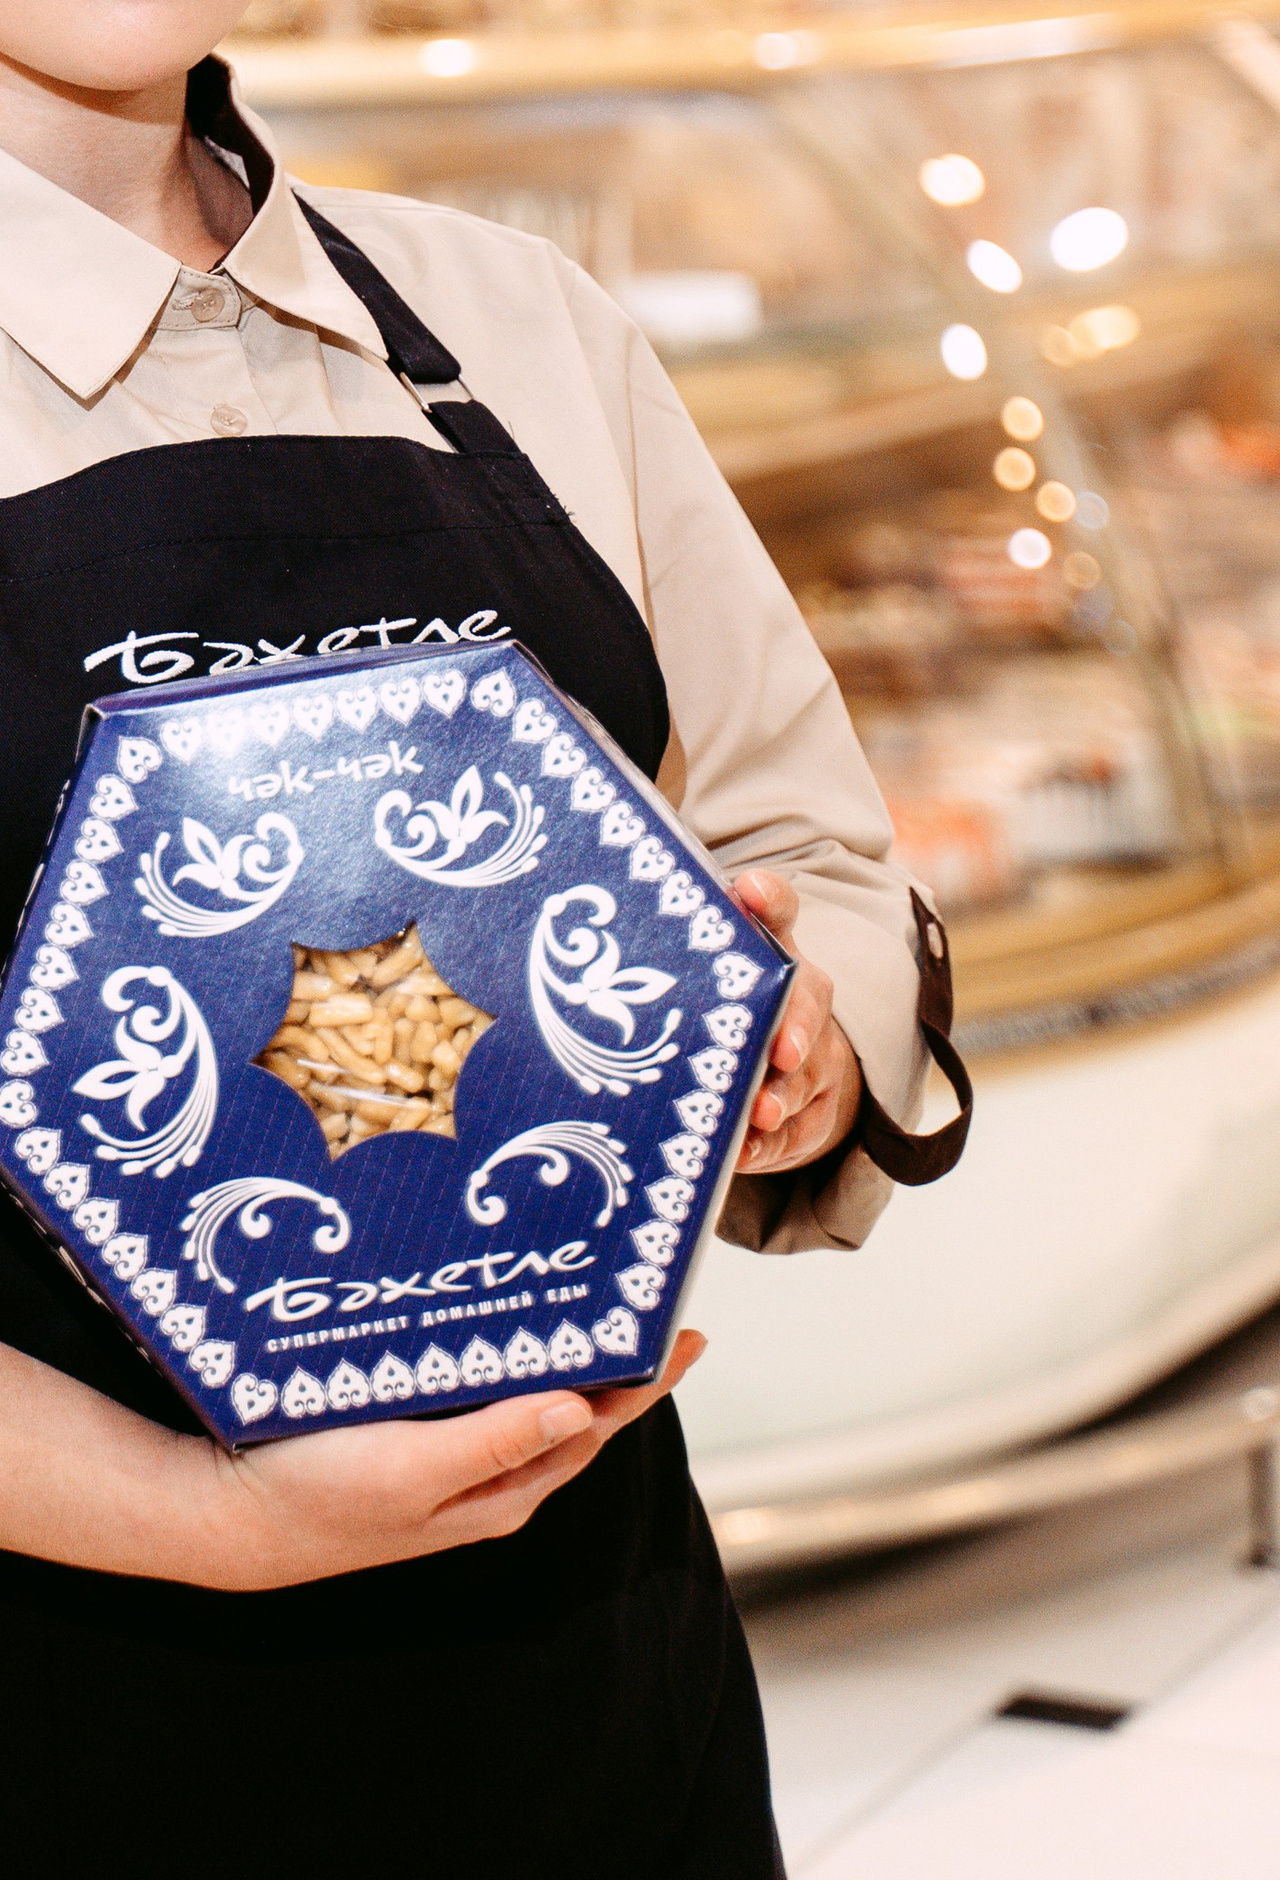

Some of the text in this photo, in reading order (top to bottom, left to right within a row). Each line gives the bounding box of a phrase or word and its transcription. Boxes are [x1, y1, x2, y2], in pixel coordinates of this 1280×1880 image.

[267, 1282, 591, 1353] СУПЕРМАРКЕТ ДОМАШНЕЙ ЕДЫ
